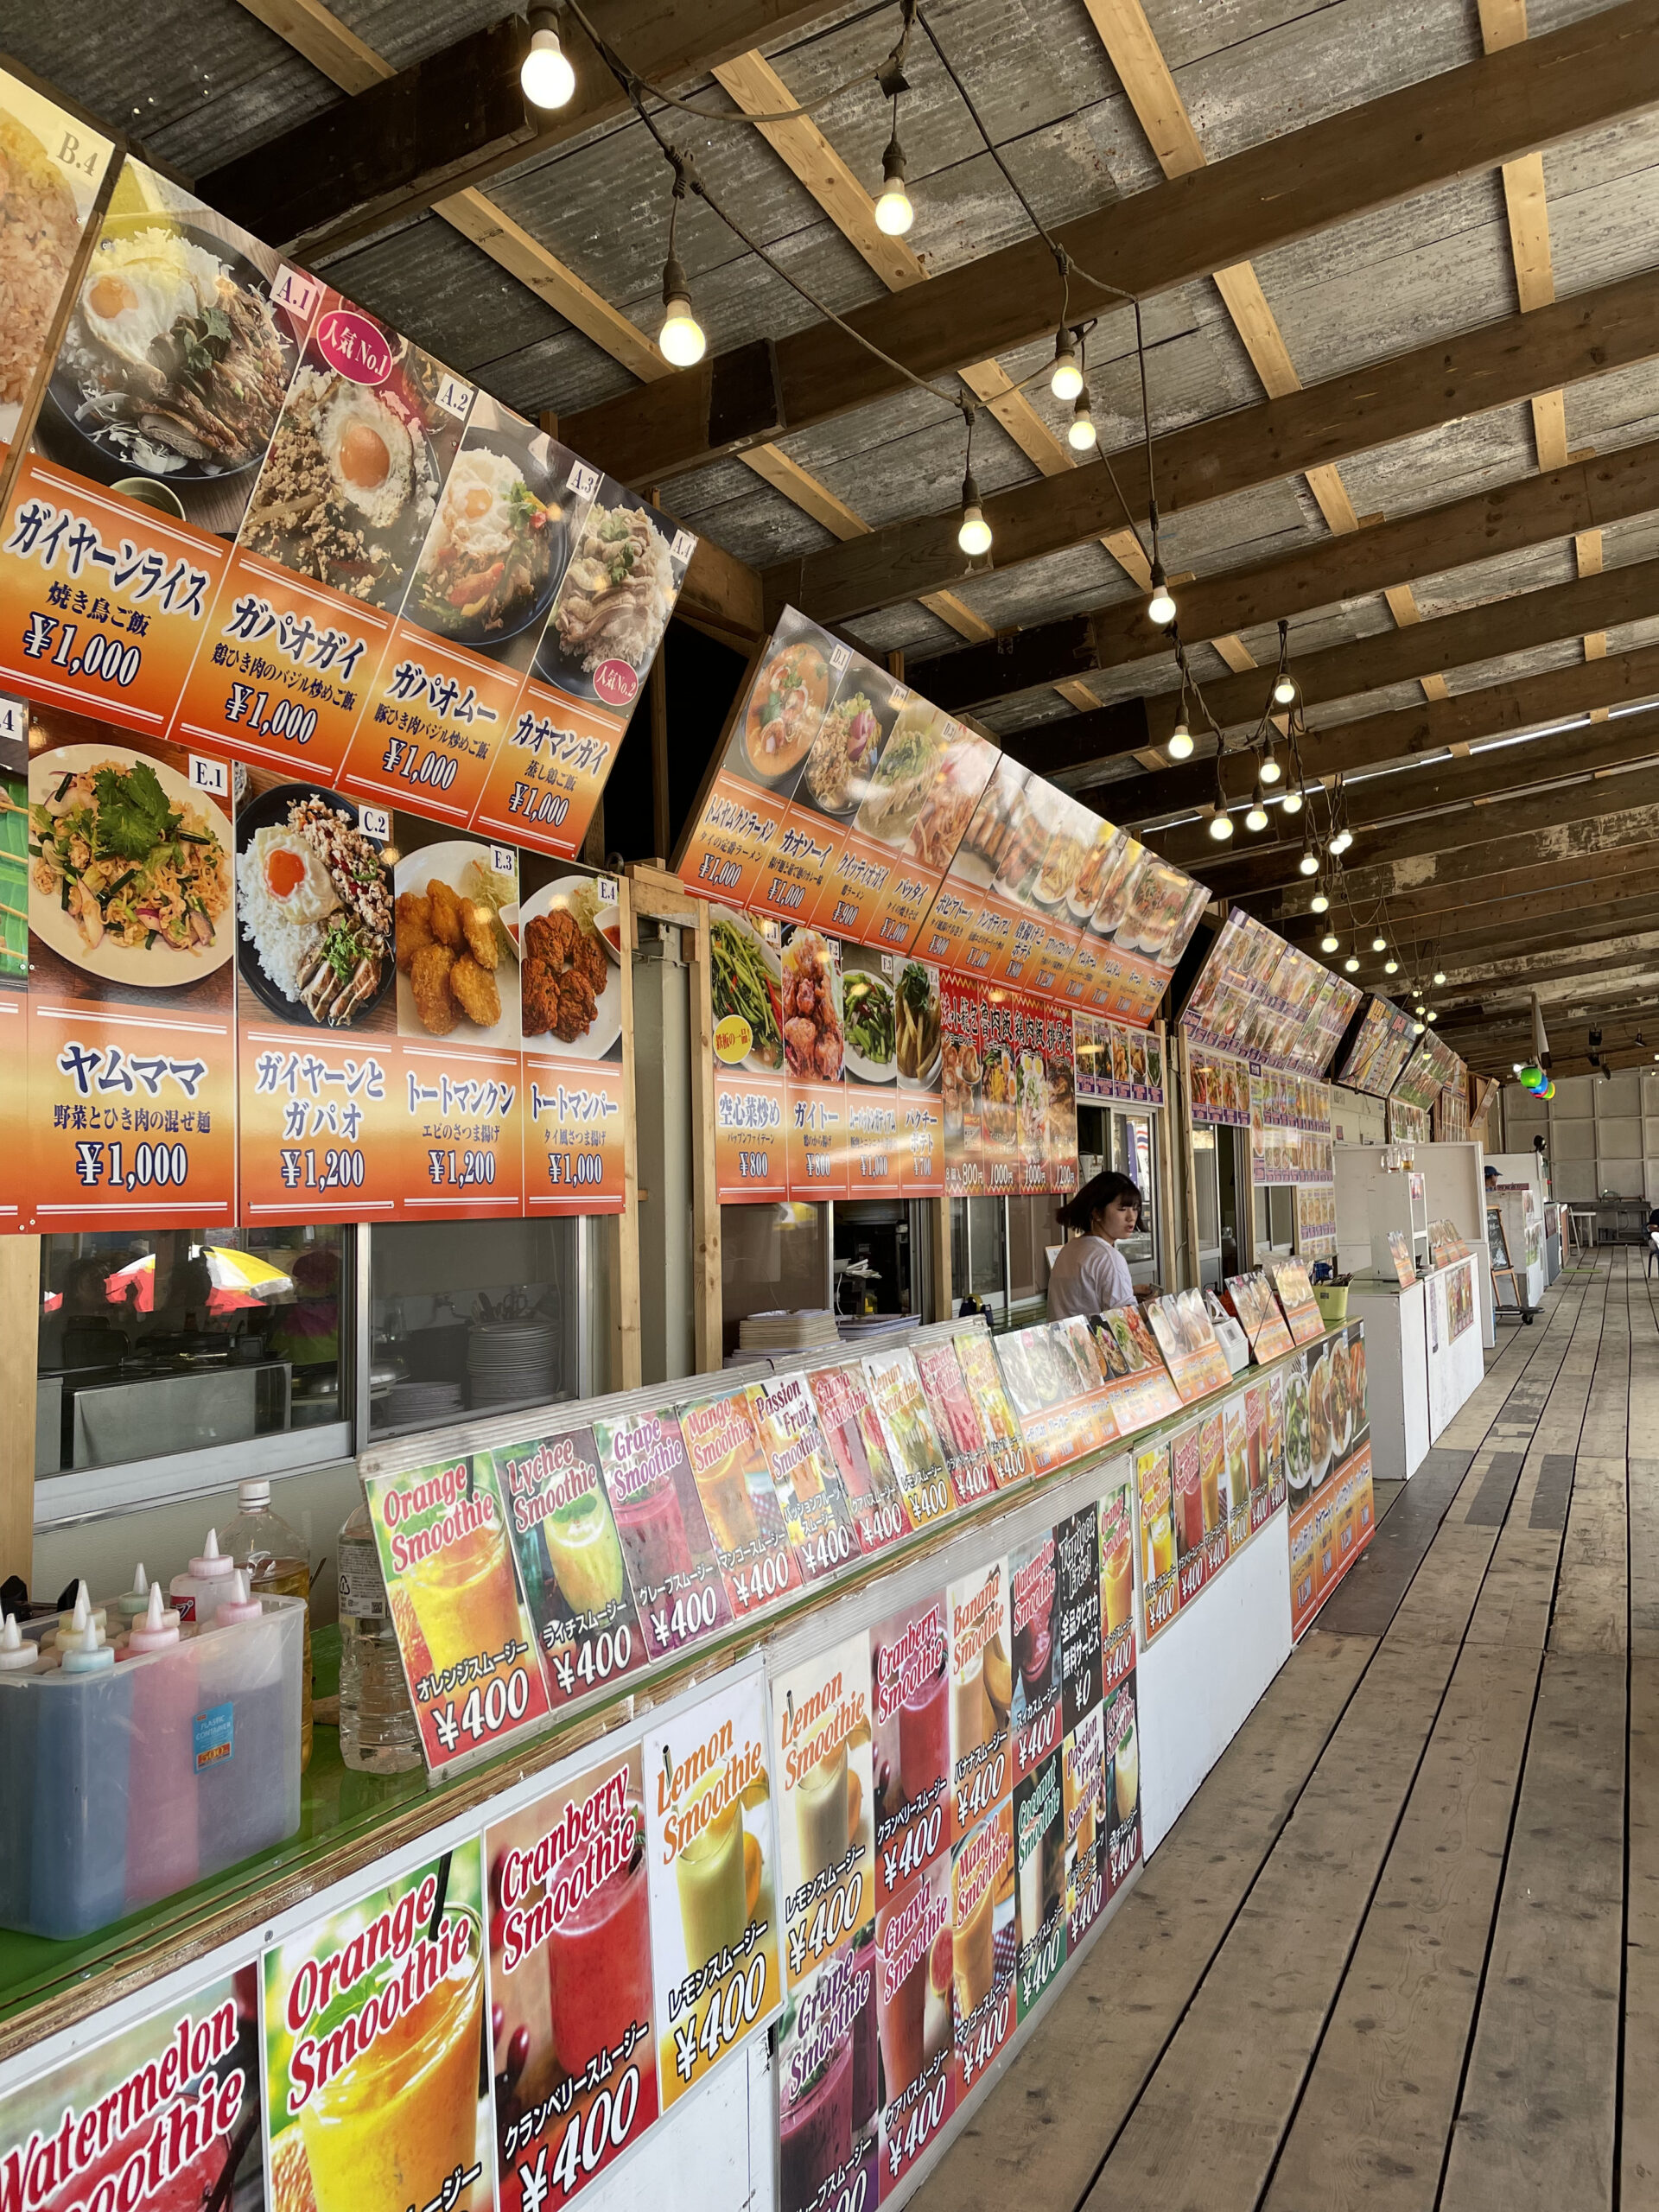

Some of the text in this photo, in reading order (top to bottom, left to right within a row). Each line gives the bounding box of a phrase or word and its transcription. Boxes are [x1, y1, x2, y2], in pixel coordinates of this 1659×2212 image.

[56, 130, 98, 177] B.4
[277, 276, 308, 309] A.1
[440, 383, 469, 412] A.2
[570, 468, 594, 493] A.3
[4, 499, 210, 616] ガイヤーンライス
[674, 540, 690, 559] A.4
[46, 581, 151, 638] 焼き鳥ご飯
[22, 613, 142, 686] ¥1,000
[223, 597, 366, 683] ガパオガイ
[210, 643, 358, 712] 鶏ひき肉のバジル炒めご飯
[385, 660, 499, 724] ガパオムー
[225, 683, 317, 744] ¥1,000
[373, 703, 491, 760] 豚ひき肉バジル炒めご飯
[195, 761, 222, 787] E.1
[382, 737, 458, 790] ¥1,000
[509, 714, 609, 779] カオマンガイ
[524, 760, 576, 792] 蒸し鶏ご飯
[364, 811, 386, 833] C.2
[509, 782, 569, 827] ¥1,000
[493, 849, 512, 871] E.3
[698, 853, 742, 888] ¥1,000
[779, 828, 833, 869] カオソーイ
[600, 881, 615, 900] E.4
[767, 878, 806, 909] ¥1,000
[832, 900, 859, 926] ¥900
[58, 1042, 207, 1099] ヤムママ
[256, 1052, 385, 1101] ガイヤーンと
[406, 1071, 516, 1118] トートマンクン
[54, 1104, 211, 1134] 野菜とひき肉の混ぜ麺
[283, 1099, 363, 1142] ガパオ
[531, 1083, 618, 1122] トートマンパー
[719, 1093, 779, 1128] 空心菜炒め
[794, 1102, 839, 1131] ガイトー
[422, 1124, 500, 1143] エビのさつま揚げ
[76, 1141, 188, 1192] ¥1,000
[281, 1149, 365, 1192] ¥1,200
[429, 1149, 495, 1188] ¥1,200
[549, 1154, 602, 1187] ¥1,000
[739, 1152, 768, 1178] ¥800
[805, 1153, 831, 1177] ¥800
[860, 1154, 888, 1179] ¥1,000
[755, 1379, 802, 1422] Passion
[815, 1371, 849, 1404] Guava
[870, 1363, 900, 1395] Lemon
[878, 1377, 918, 1420] Smoothie
[613, 1417, 661, 1461] Grape
[687, 1397, 732, 1442] Mango
[782, 1402, 812, 1438] Fruit
[824, 1389, 868, 1433] Smoothie
[508, 1438, 574, 1497] Lychee
[614, 1438, 683, 1501] Smoothie
[694, 1417, 751, 1473] Smoothie
[772, 1428, 821, 1479] Smoothie
[995, 1446, 1026, 1483] ¥400
[384, 1463, 467, 1527] Orange
[514, 1462, 598, 1533] Smoothie
[910, 1480, 948, 1522] ¥400
[956, 1464, 989, 1499] ¥400
[392, 1492, 495, 1573] Smoothie
[720, 1533, 785, 1570] マンゴースムージー
[801, 1525, 850, 1574] ¥400
[804, 1513, 836, 1535] スムージー
[861, 1502, 902, 1547] ¥400
[639, 1564, 714, 1605] グレープスムージー
[734, 1552, 789, 1608] ¥400
[1014, 1538, 1055, 1603] Watermelon
[1181, 1557, 1204, 1600] ¥400
[543, 1603, 627, 1649] ライチスムージー
[652, 1586, 717, 1649] ¥400
[953, 1571, 1000, 1638] Banana
[1014, 1567, 1056, 1637] Smoothie
[1061, 1593, 1099, 1643] 全品タピオカ
[1147, 1582, 1175, 1631] ¥400
[553, 1624, 632, 1696] ¥400
[878, 1603, 939, 1686] Cranberry
[953, 1603, 1004, 1676] Smoothie
[1062, 1626, 1100, 1680] 無料サービス
[1106, 1634, 1132, 1686] ¥400
[416, 1643, 528, 1702] オレンジスムージー
[878, 1637, 943, 1726] Smoothie
[1075, 1669, 1091, 1710] ¥0
[432, 1669, 530, 1751] ¥400
[781, 1671, 842, 1750] Lemon
[785, 1691, 864, 1790] Smoothie
[955, 1730, 1007, 1780] バナナスムージー
[1018, 1706, 1056, 1772] ¥400
[1065, 1714, 1098, 1779] Passion
[1080, 1739, 1101, 1788] Fruit
[658, 1719, 734, 1817] Lemon
[957, 1752, 1005, 1827] ¥400
[664, 1740, 762, 1865] Smoothie
[877, 1775, 947, 1846] クランベリースムージー
[1018, 1755, 1057, 1839] Coconut
[1067, 1764, 1103, 1843] Smoothie
[500, 1764, 629, 1912] Cranberry
[883, 1804, 942, 1892] ¥400
[958, 1814, 999, 1890] Mango
[1018, 1787, 1061, 1873] Smoothie
[1110, 1826, 1137, 1887] ¥400
[502, 1817, 636, 1974] Smoothie
[785, 1845, 866, 1923] レモンスムージー
[957, 1832, 1010, 1929] Smoothie
[788, 1871, 863, 1975] ¥400
[883, 1878, 931, 1960] Guava
[1071, 1874, 1102, 1944] ¥400
[286, 1874, 438, 2033] Orange
[668, 1921, 769, 2023] レモンスムージー
[885, 1895, 948, 2005] Smoothie
[1021, 1929, 1061, 2009] ¥400
[288, 1916, 472, 2114] Smoothie
[676, 1955, 767, 2082] ¥400
[798, 1948, 855, 2039] Grape
[789, 1968, 871, 2101] Smoothie
[963, 1995, 1009, 2086] ¥400
[504, 2020, 650, 2160] クランベリースムージー
[519, 2065, 640, 2212] ¥400
[888, 2074, 947, 2177] ¥400
